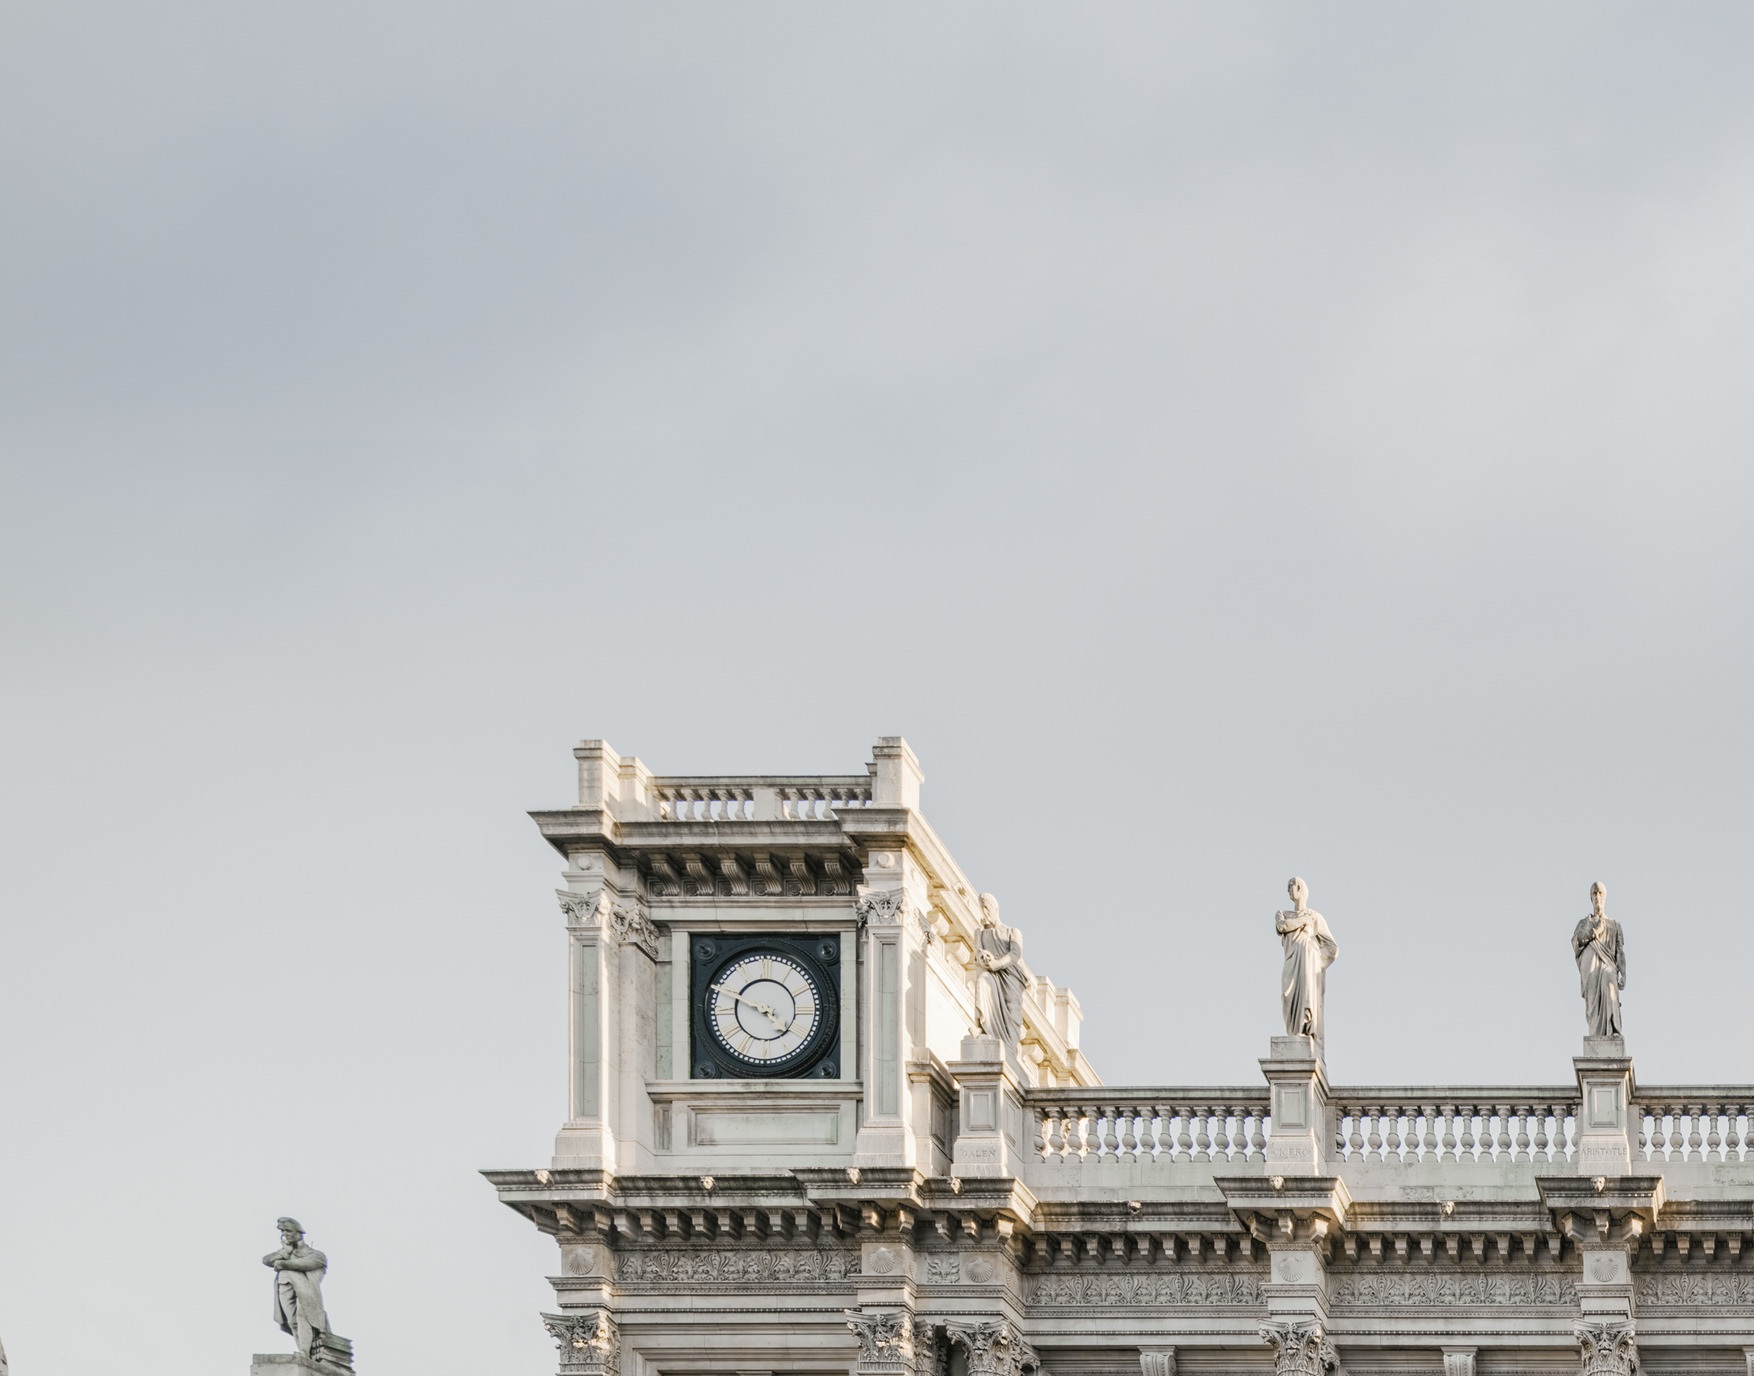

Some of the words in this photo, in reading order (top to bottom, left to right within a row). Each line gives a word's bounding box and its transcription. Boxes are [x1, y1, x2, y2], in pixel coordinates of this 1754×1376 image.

[961, 1150, 996, 1158] GALEN
[1272, 1148, 1309, 1157] CICERO
[1581, 1148, 1627, 1156] ARISTOTLE
